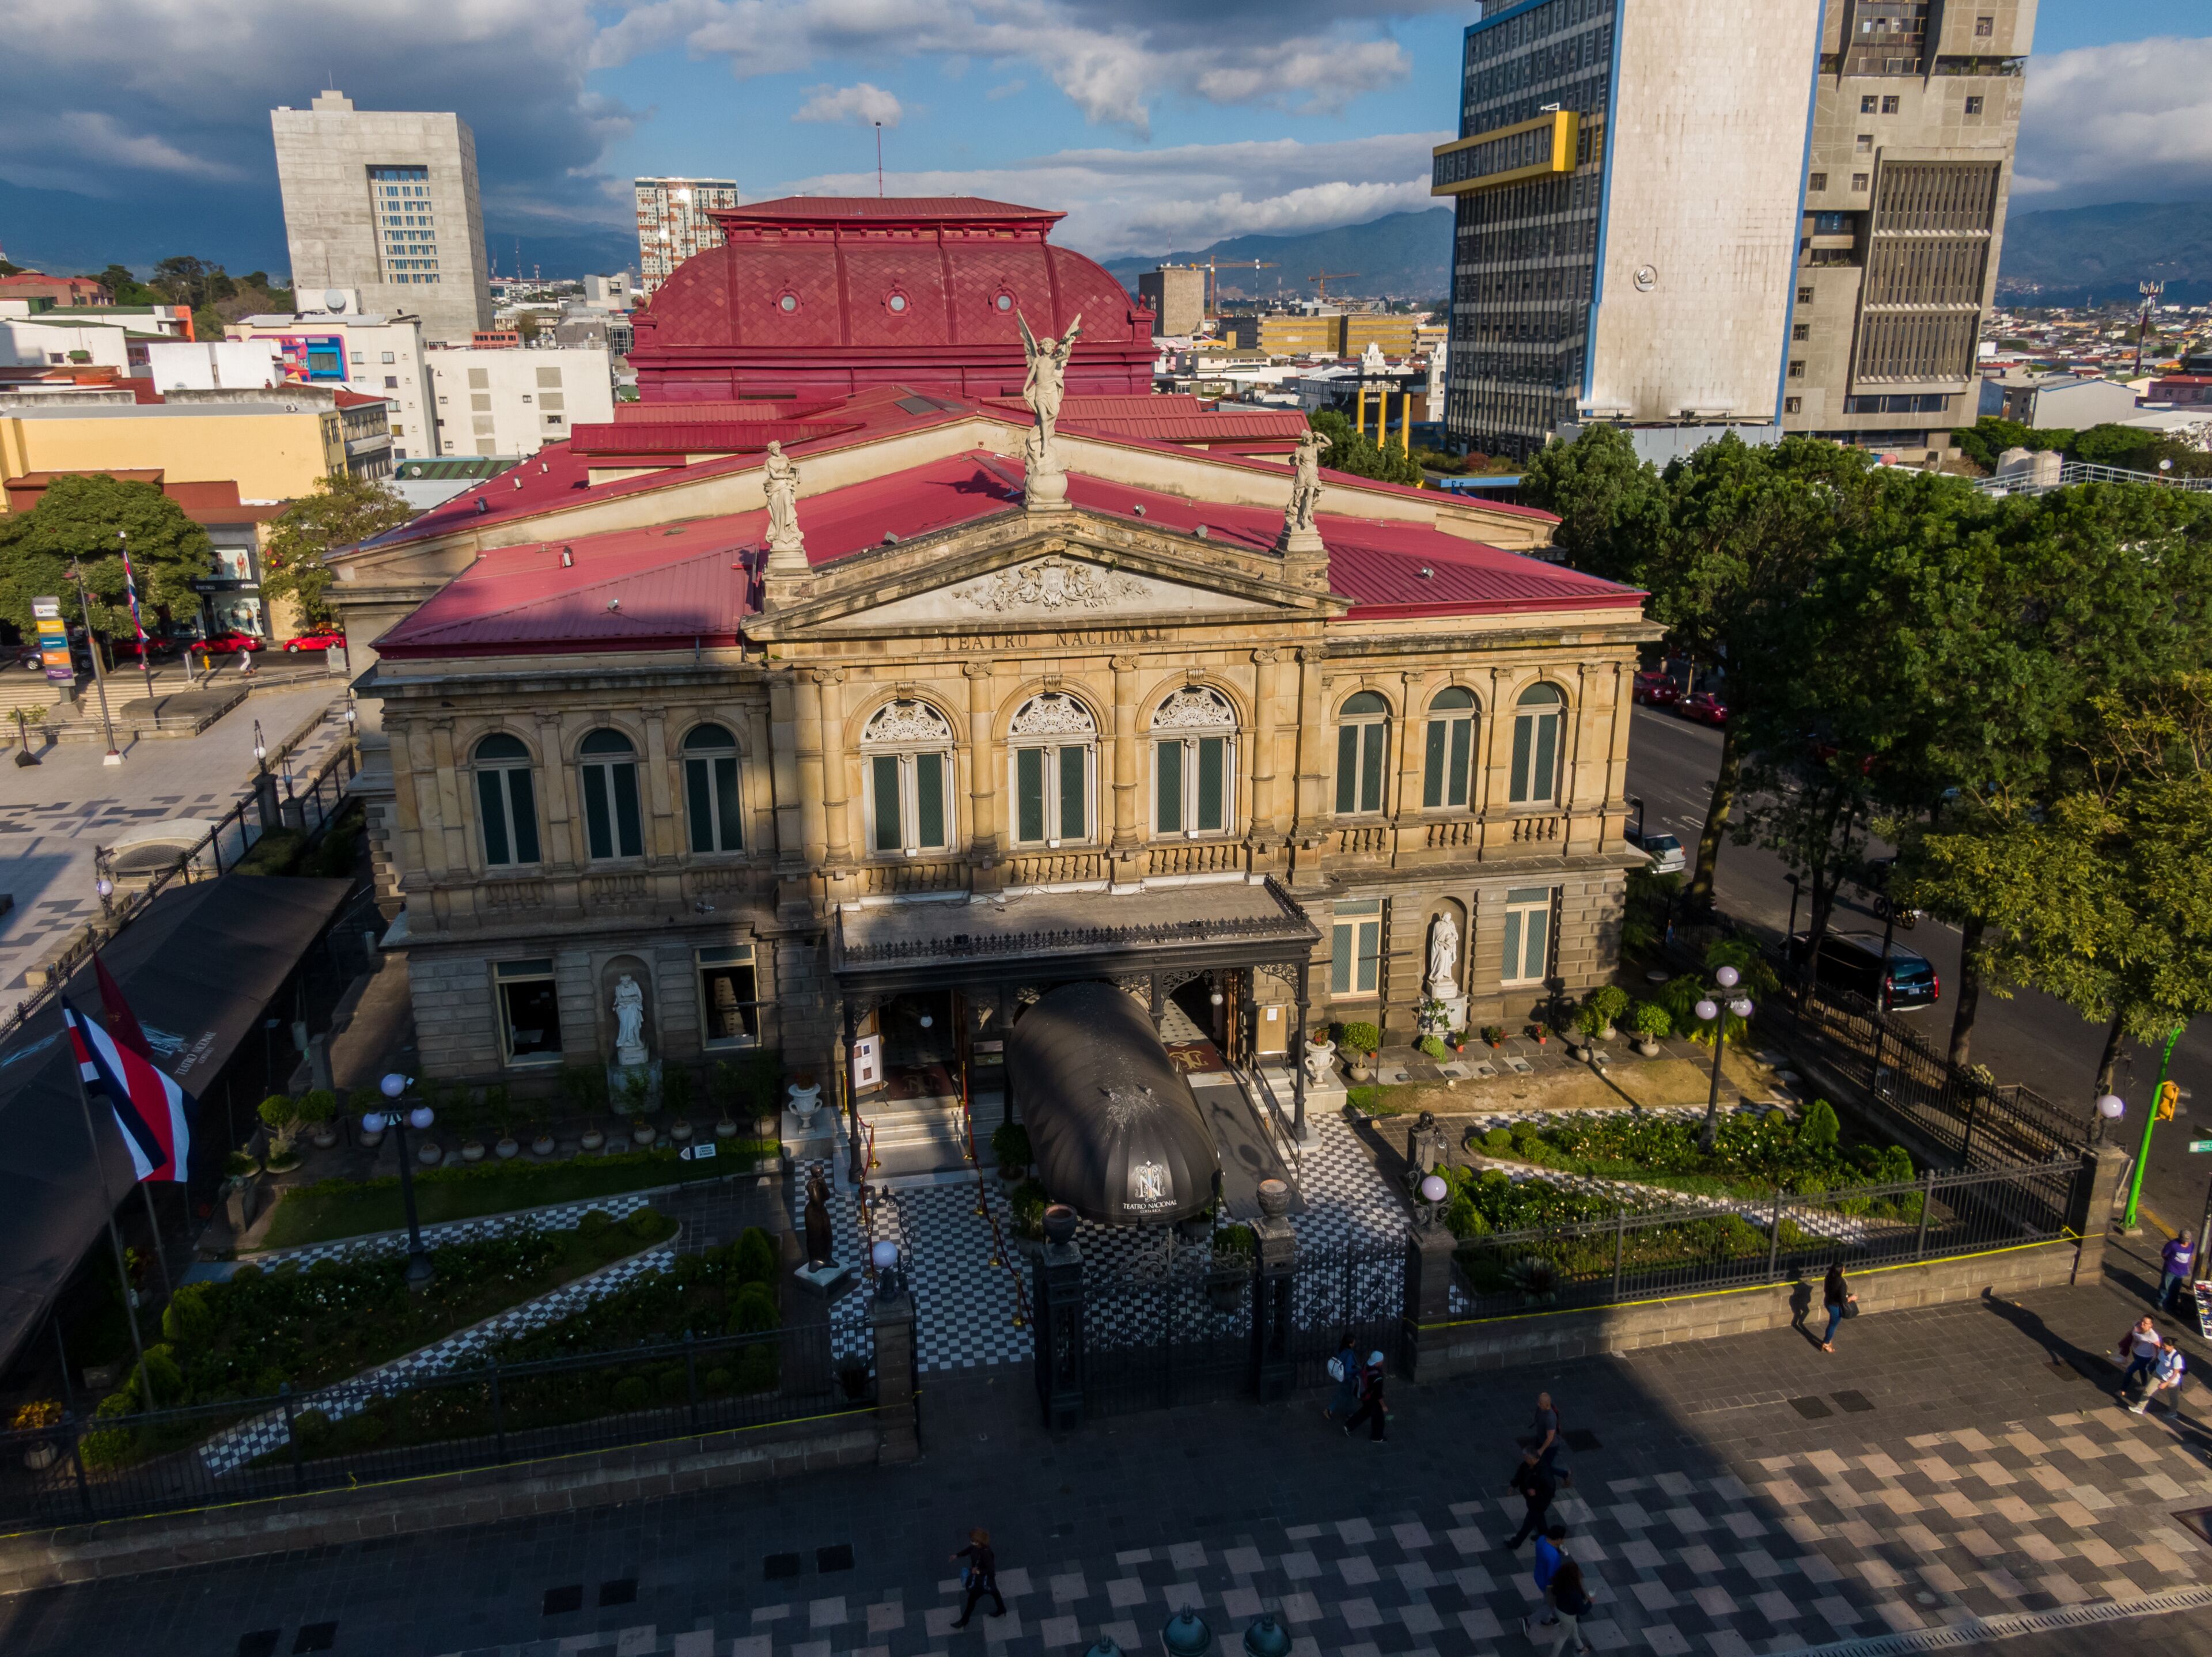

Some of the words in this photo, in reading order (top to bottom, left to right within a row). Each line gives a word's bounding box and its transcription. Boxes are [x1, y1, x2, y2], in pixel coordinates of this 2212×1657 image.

[941, 634, 1028, 651] TEATRO
[1055, 627, 1166, 646] NACIONAL
[175, 1054, 197, 1075] TEATRO
[1148, 1200, 1177, 1208] NACIONAL
